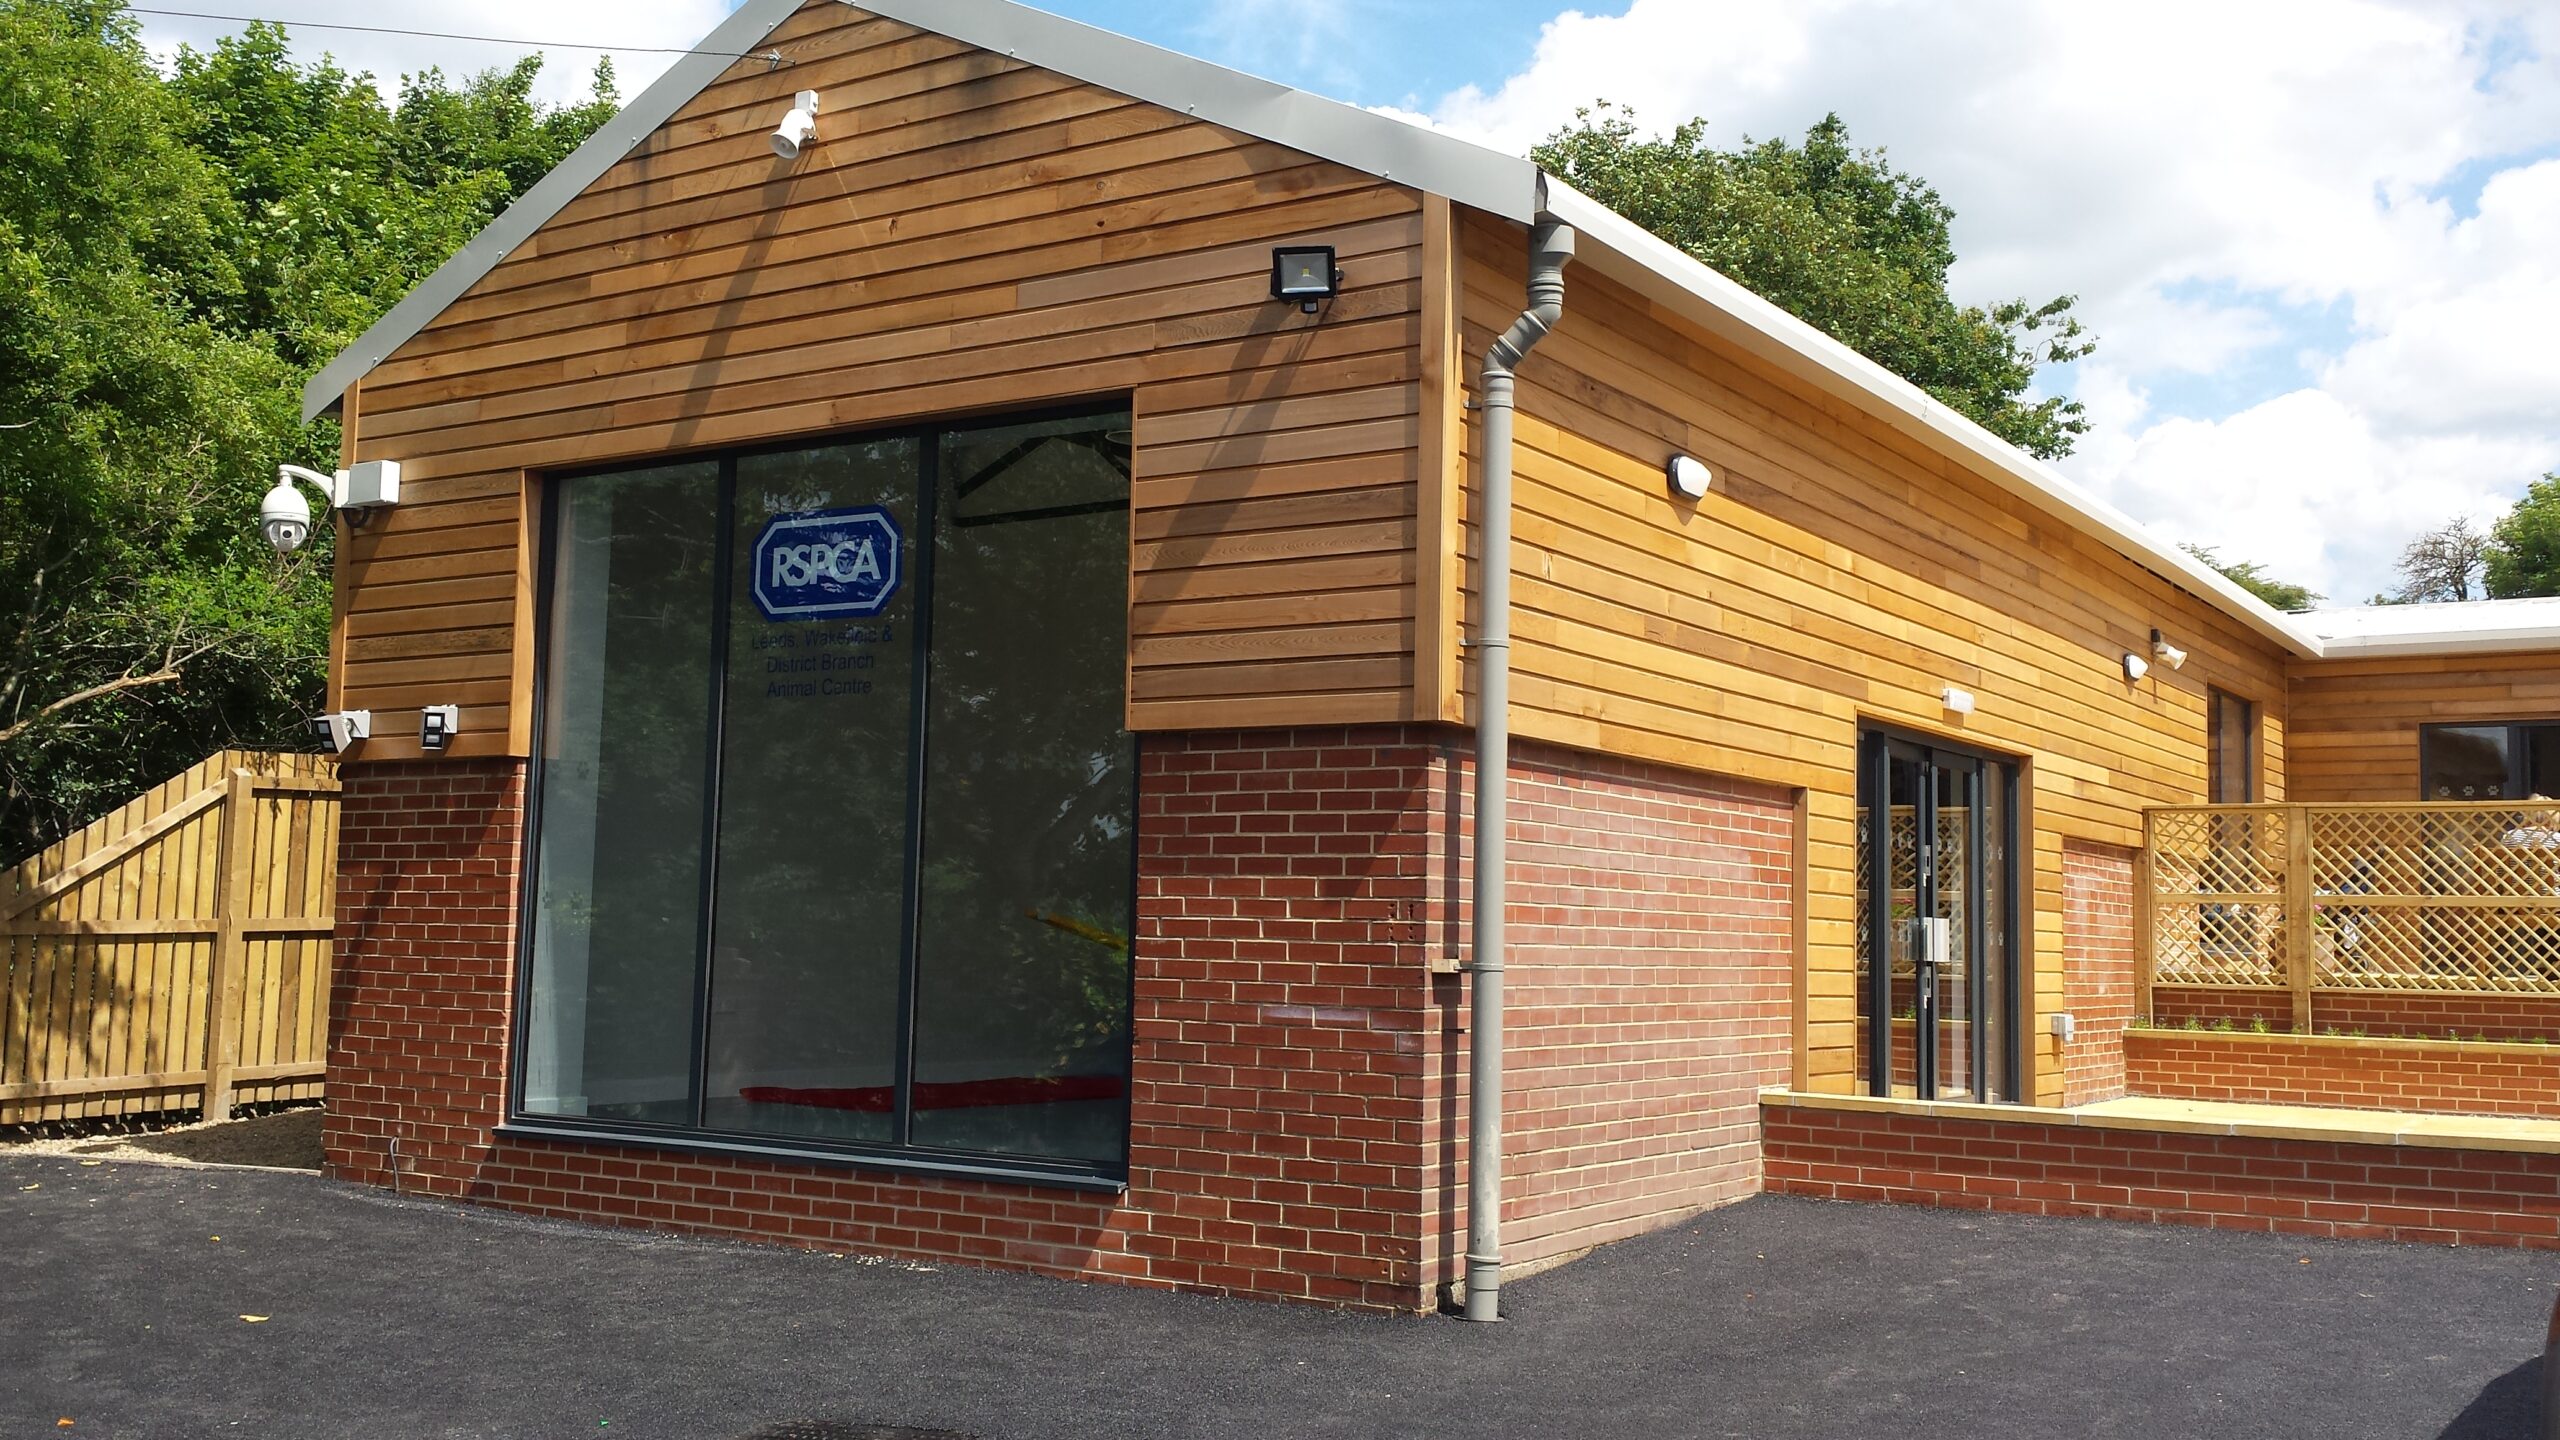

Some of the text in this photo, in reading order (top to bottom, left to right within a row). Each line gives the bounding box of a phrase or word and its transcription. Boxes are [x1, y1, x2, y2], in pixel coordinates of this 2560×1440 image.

[771, 538, 882, 588] RSPCA
[882, 624, 893, 642] &
[766, 653, 875, 673] District Branch
[766, 678, 873, 697] Animal Centre
